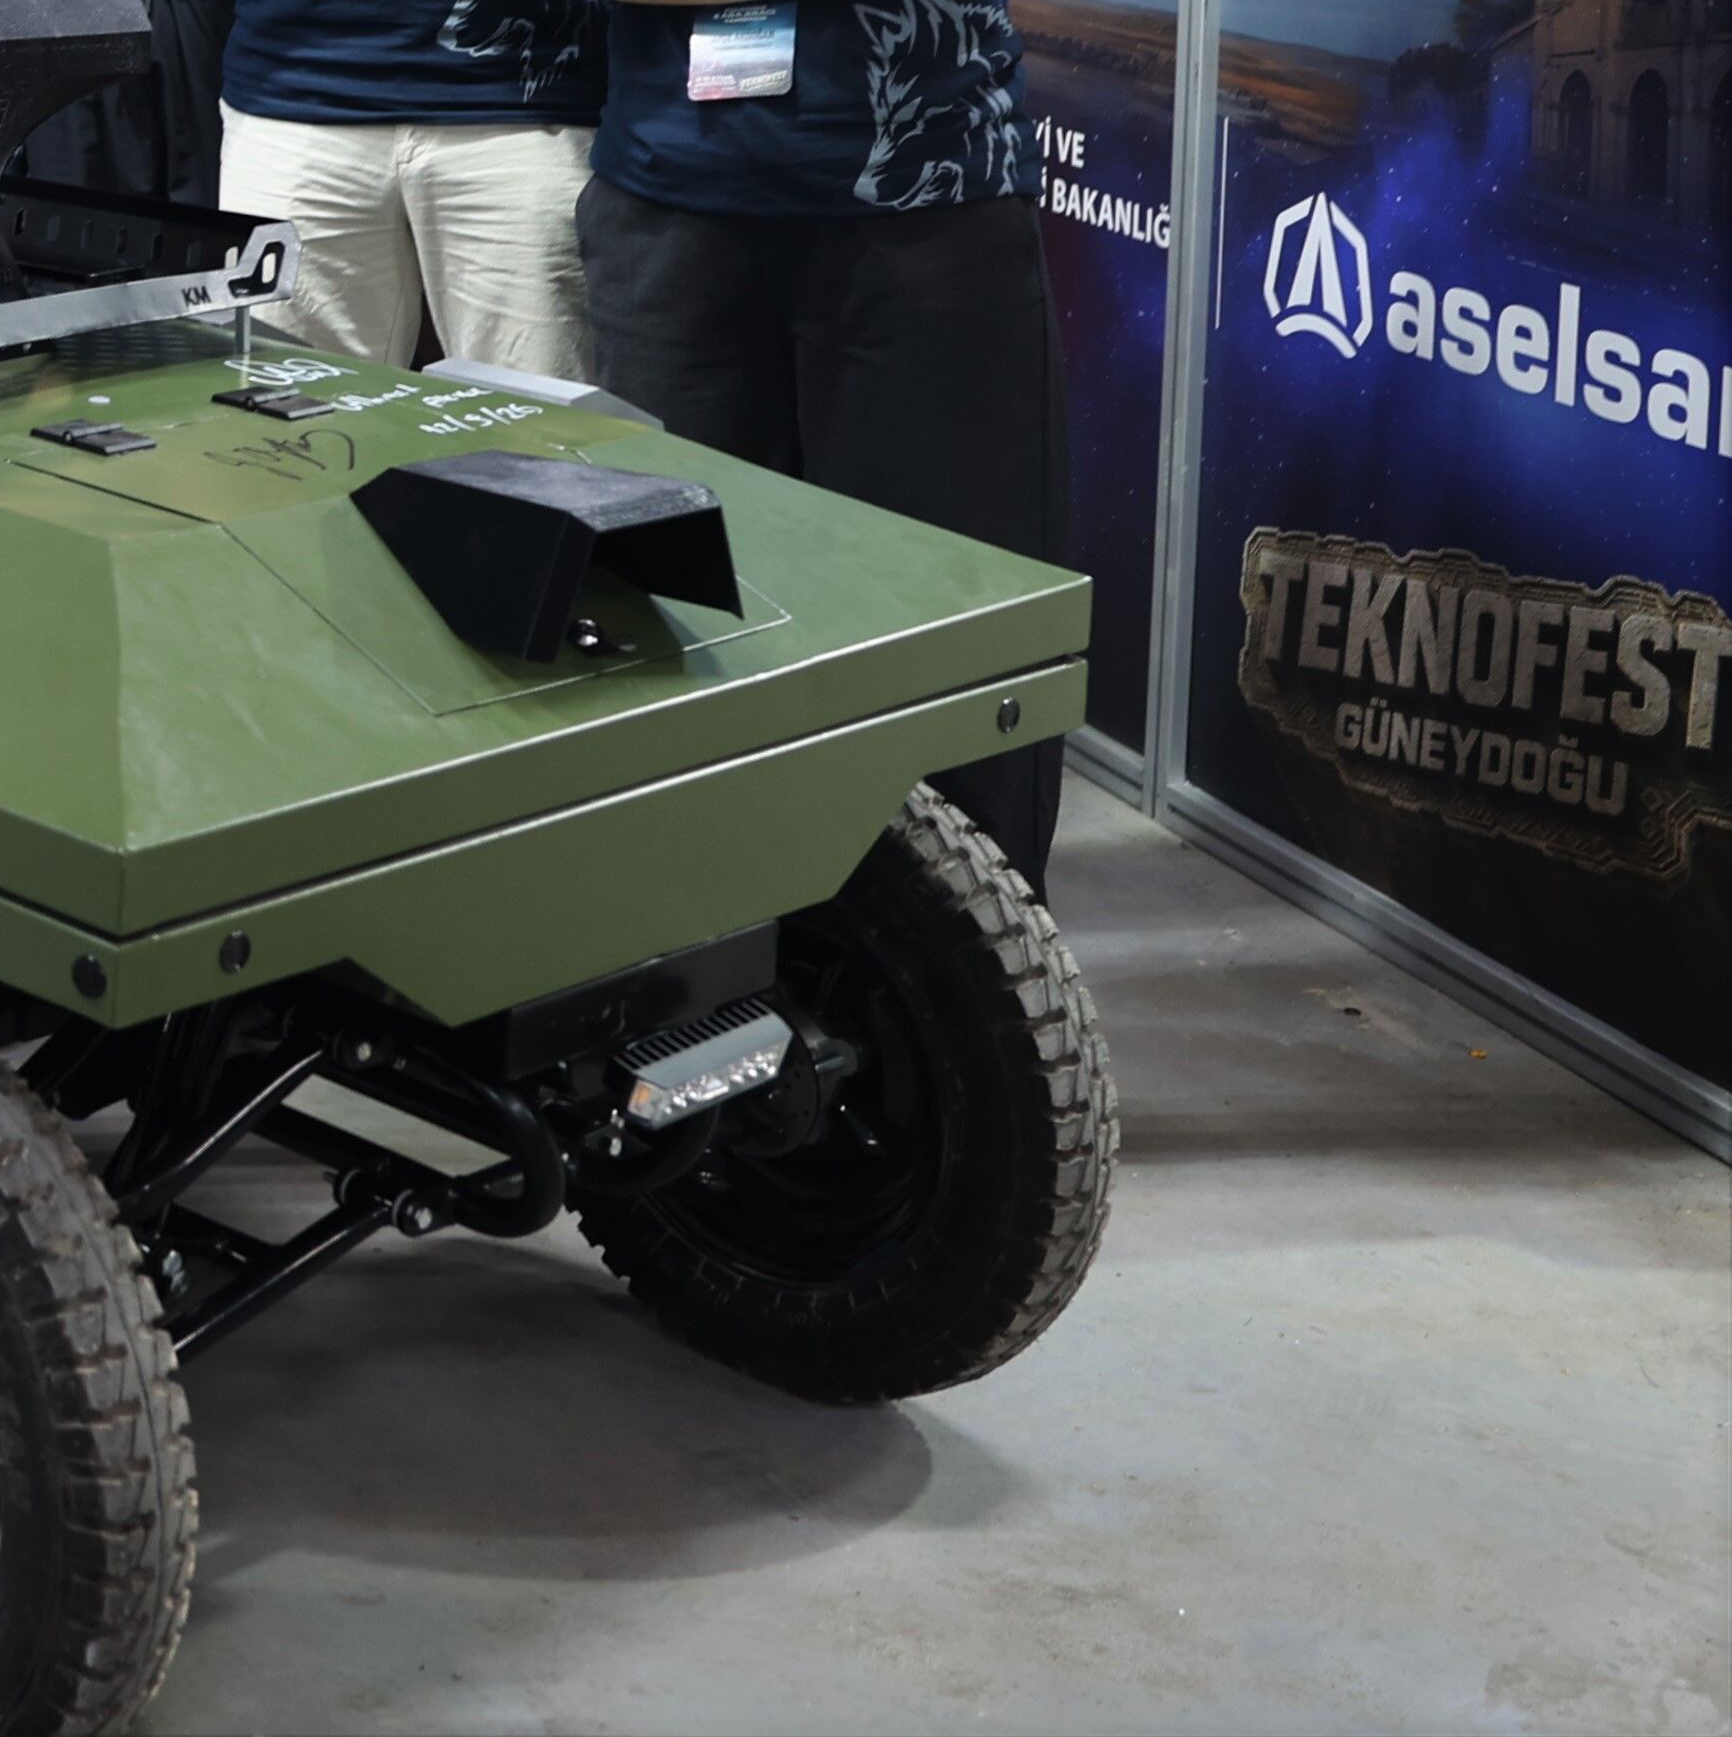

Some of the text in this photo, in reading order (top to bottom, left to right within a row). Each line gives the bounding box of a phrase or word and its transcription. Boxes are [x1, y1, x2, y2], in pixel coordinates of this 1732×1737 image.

[1056, 127, 1085, 168] VE
[1052, 176, 1170, 248] BAKANLIĞ
[181, 286, 212, 306] KM
[1386, 270, 1732, 459] aselsa
[1259, 552, 1732, 751] TEKNOFEST
[1336, 698, 1629, 816] GÜNEYDOĞU
